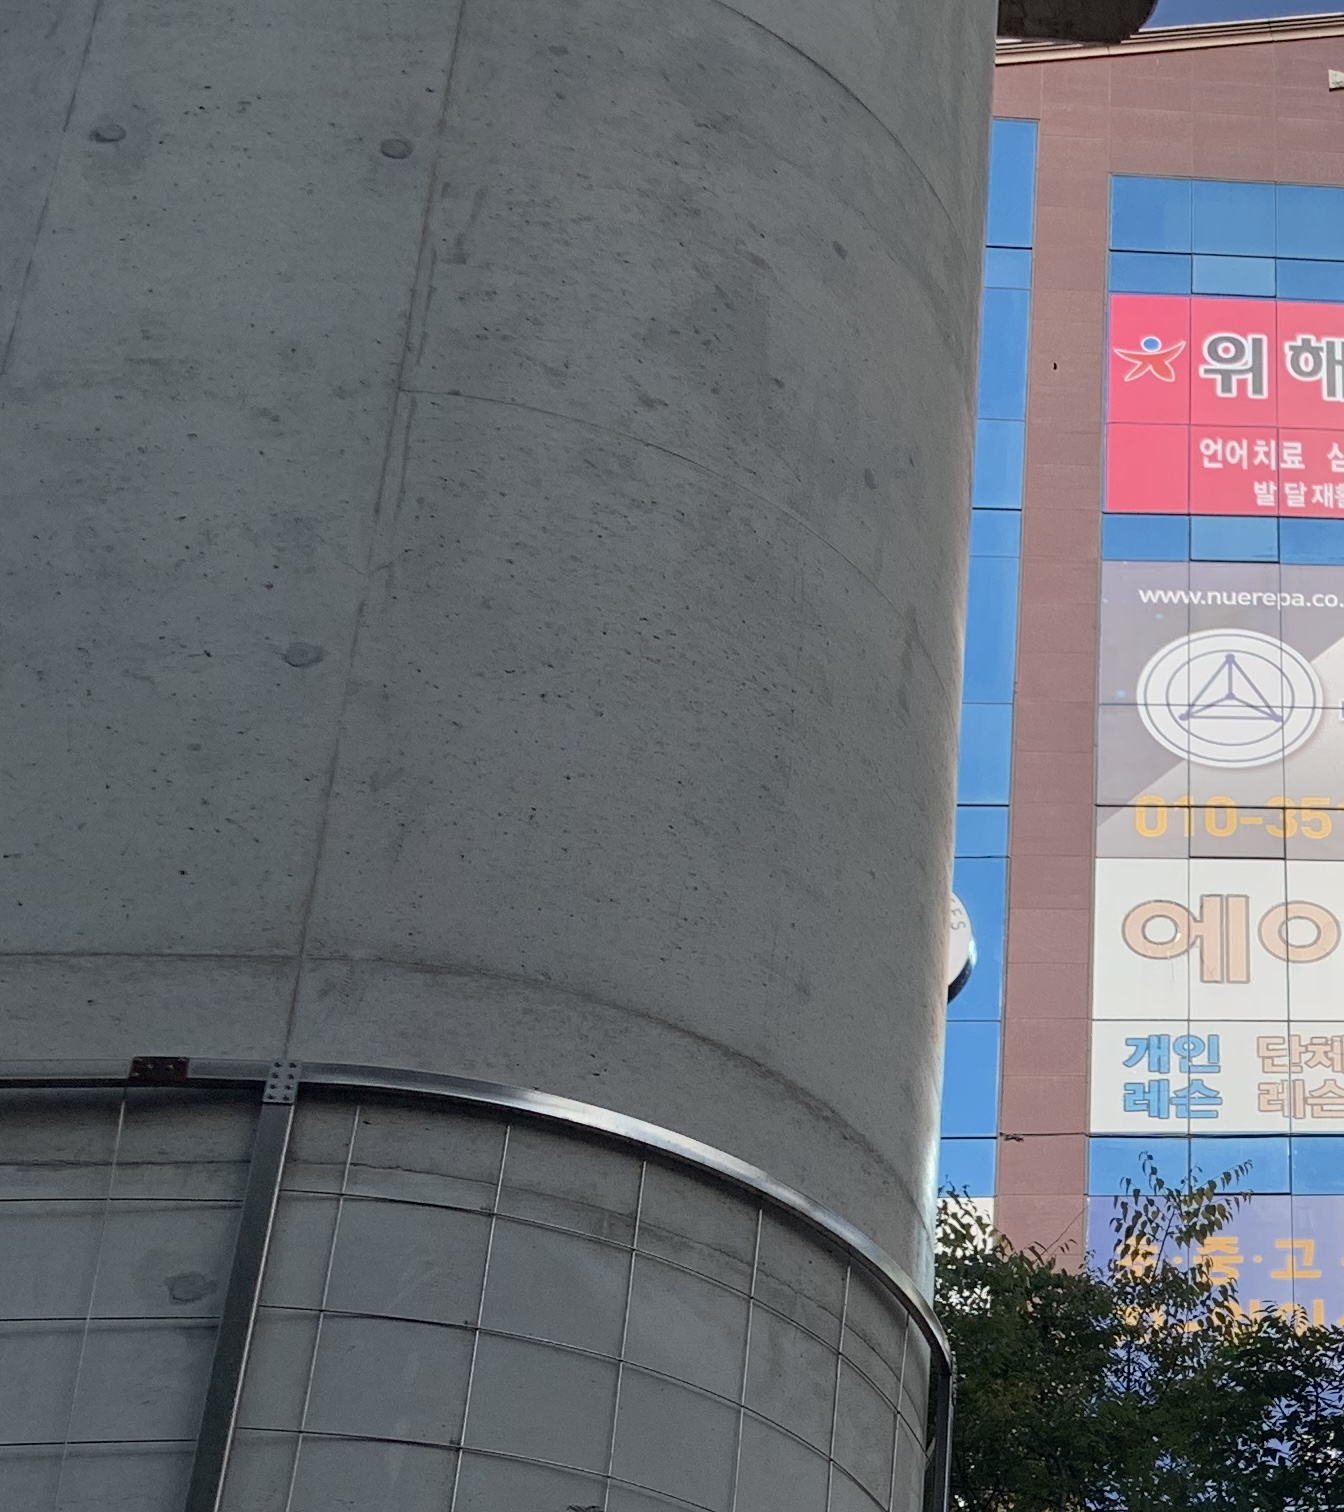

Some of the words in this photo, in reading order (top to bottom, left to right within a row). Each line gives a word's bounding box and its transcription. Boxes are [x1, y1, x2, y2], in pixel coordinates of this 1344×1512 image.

[1199, 437, 1306, 471] 언어치료
[1122, 1033, 1221, 1075] 개인
[1122, 1078, 1222, 1121] 레슨
